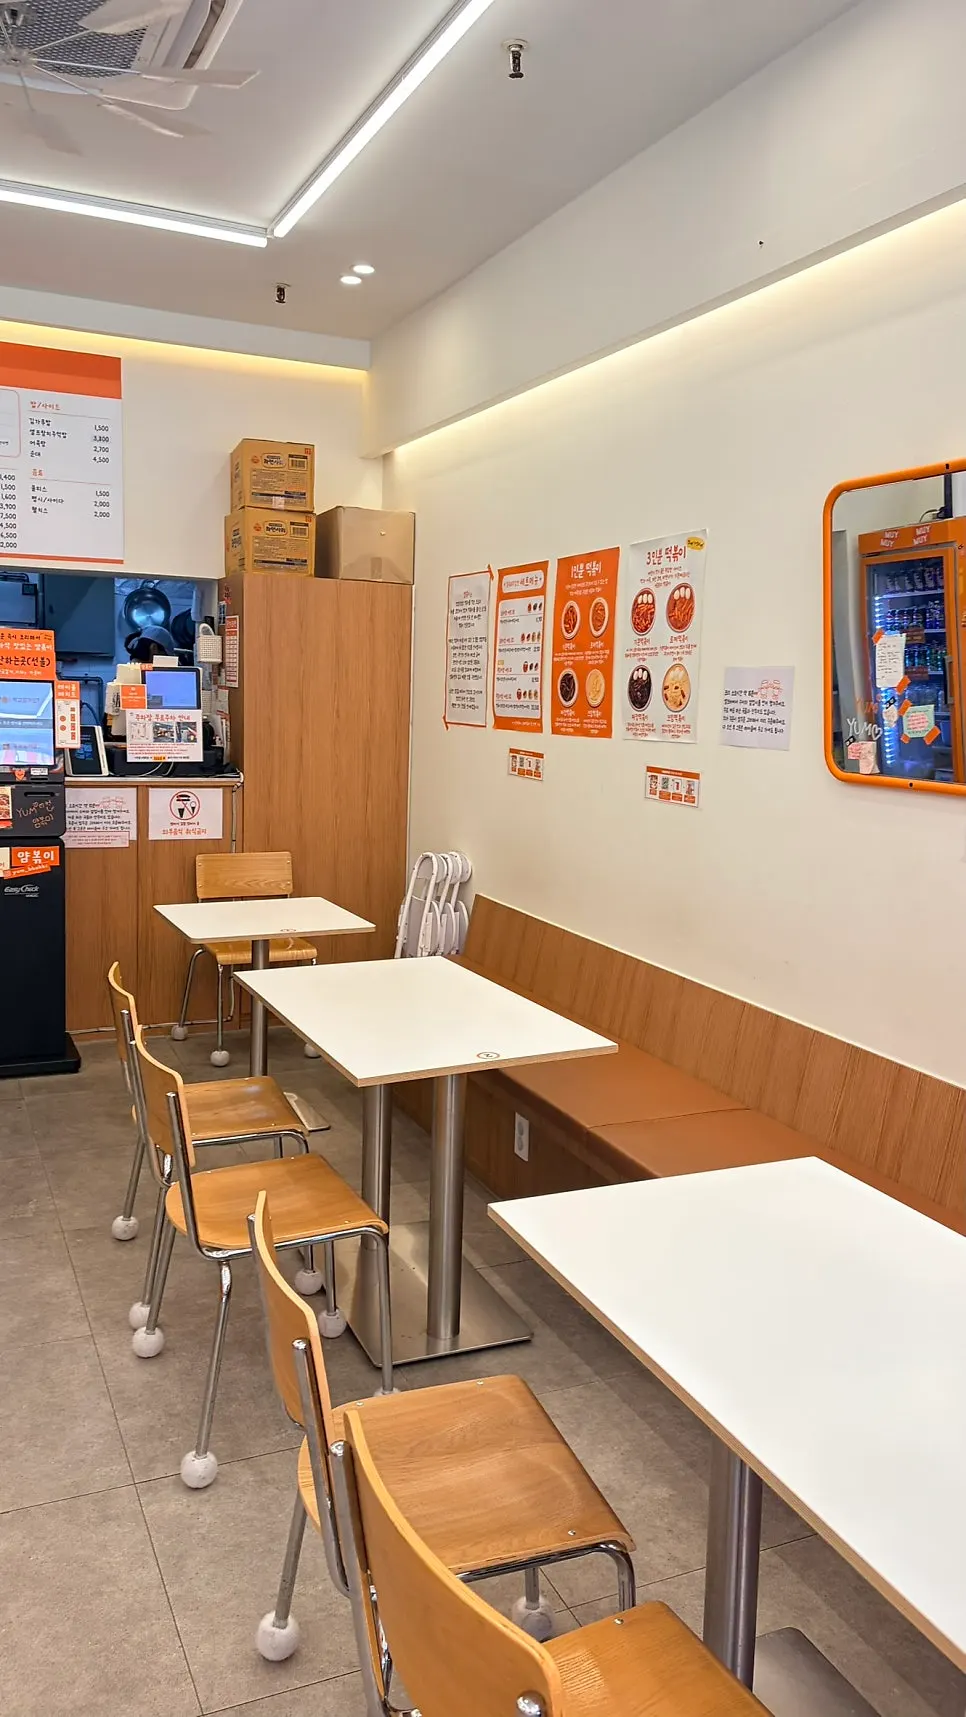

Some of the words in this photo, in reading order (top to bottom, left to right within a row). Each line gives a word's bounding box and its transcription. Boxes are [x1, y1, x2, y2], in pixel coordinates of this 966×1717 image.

[30, 401, 60, 410] 밥/사이드
[92, 456, 109, 464] 4,500
[646, 548, 663, 565] 3인분
[665, 545, 686, 562] 떡볶이
[571, 563, 585, 579] 1인분
[586, 560, 602, 577] 떡볶이
[178, 714, 190, 722] 안내
[16, 807, 37, 818] YUM
[17, 850, 54, 864] 얌볶이
